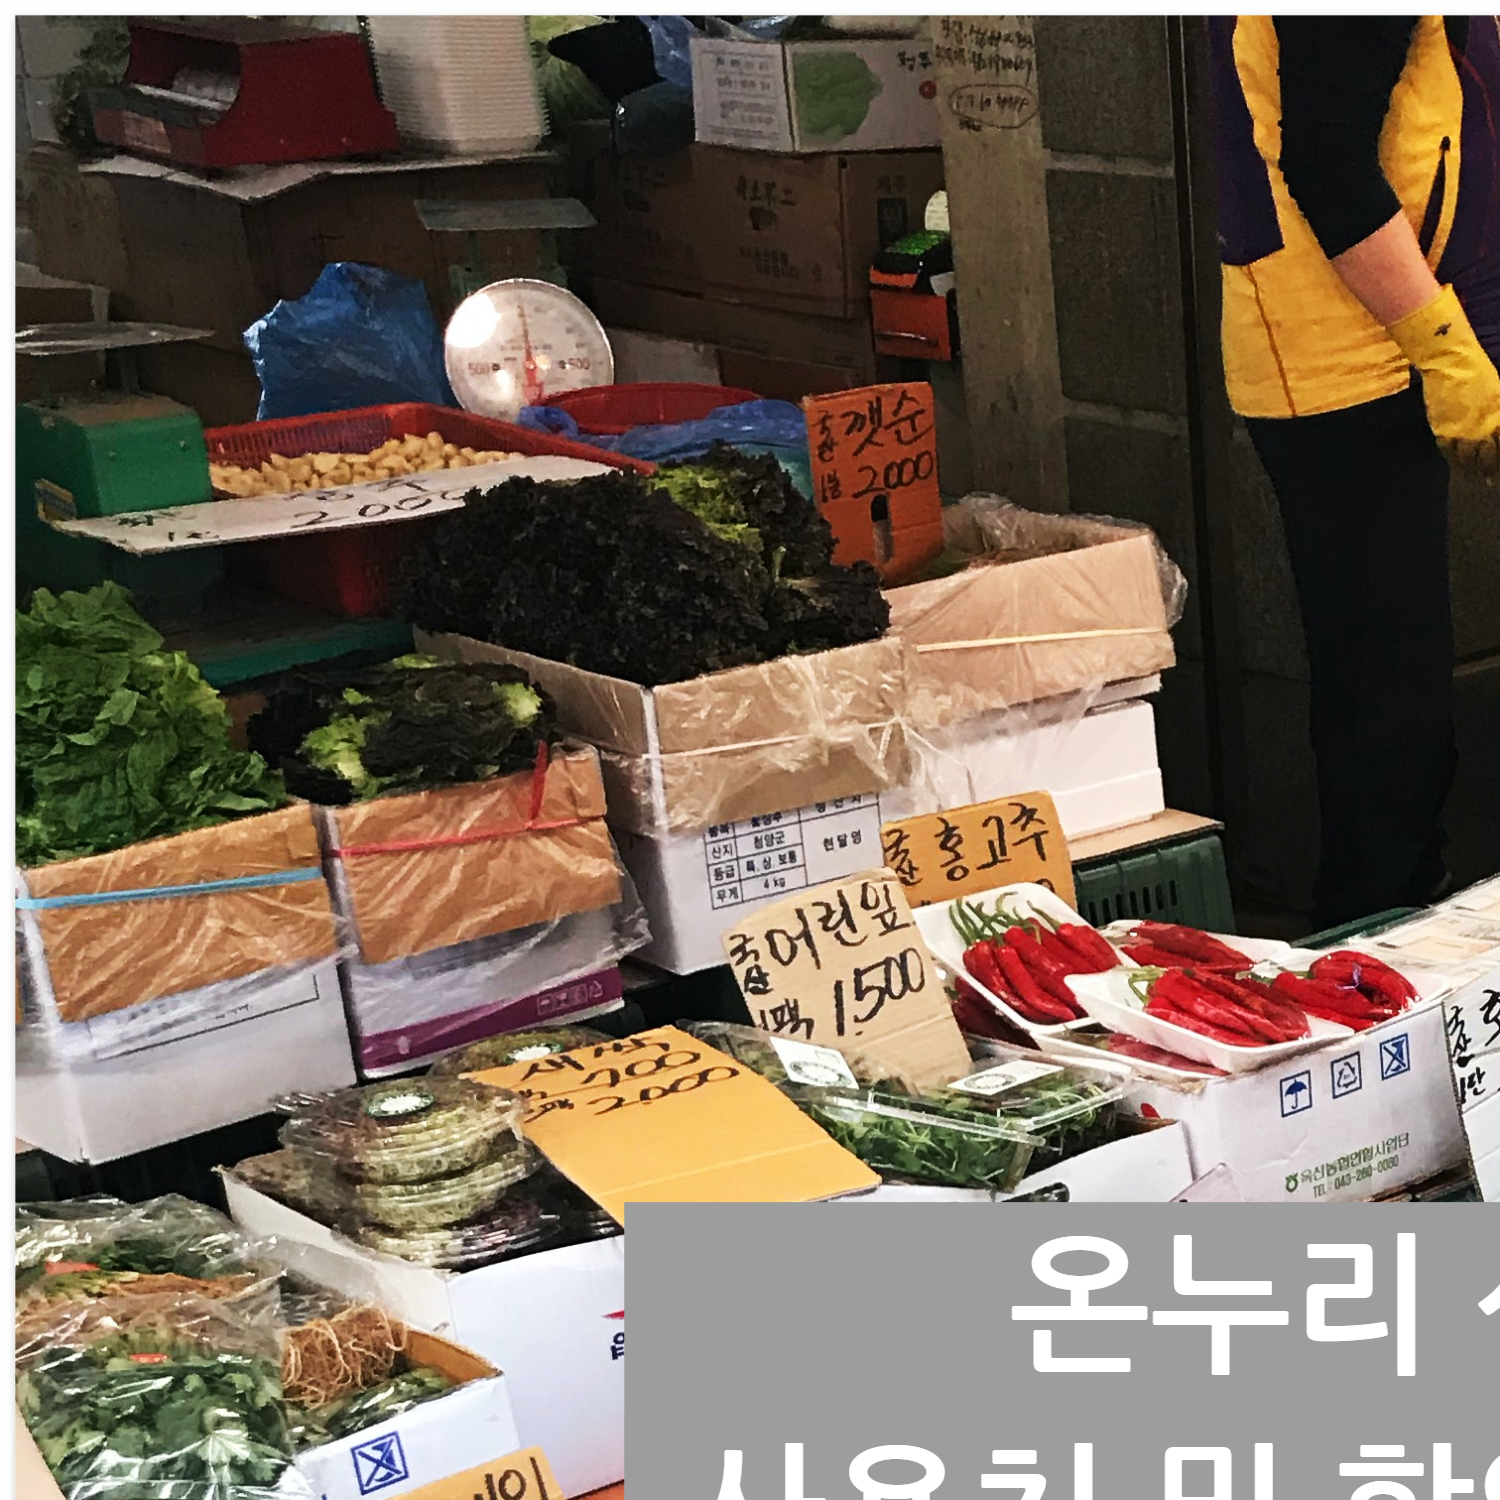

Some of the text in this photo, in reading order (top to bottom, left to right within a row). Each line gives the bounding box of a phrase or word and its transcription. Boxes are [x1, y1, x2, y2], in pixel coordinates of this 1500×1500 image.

[852, 451, 933, 498] 2000
[712, 843, 733, 858] 산지
[935, 803, 1049, 881] 홍고추
[714, 865, 735, 881] 등급
[717, 886, 739, 903] 무게
[729, 882, 914, 995] 국산 어린잎
[1459, 1067, 1486, 1104] 1단
